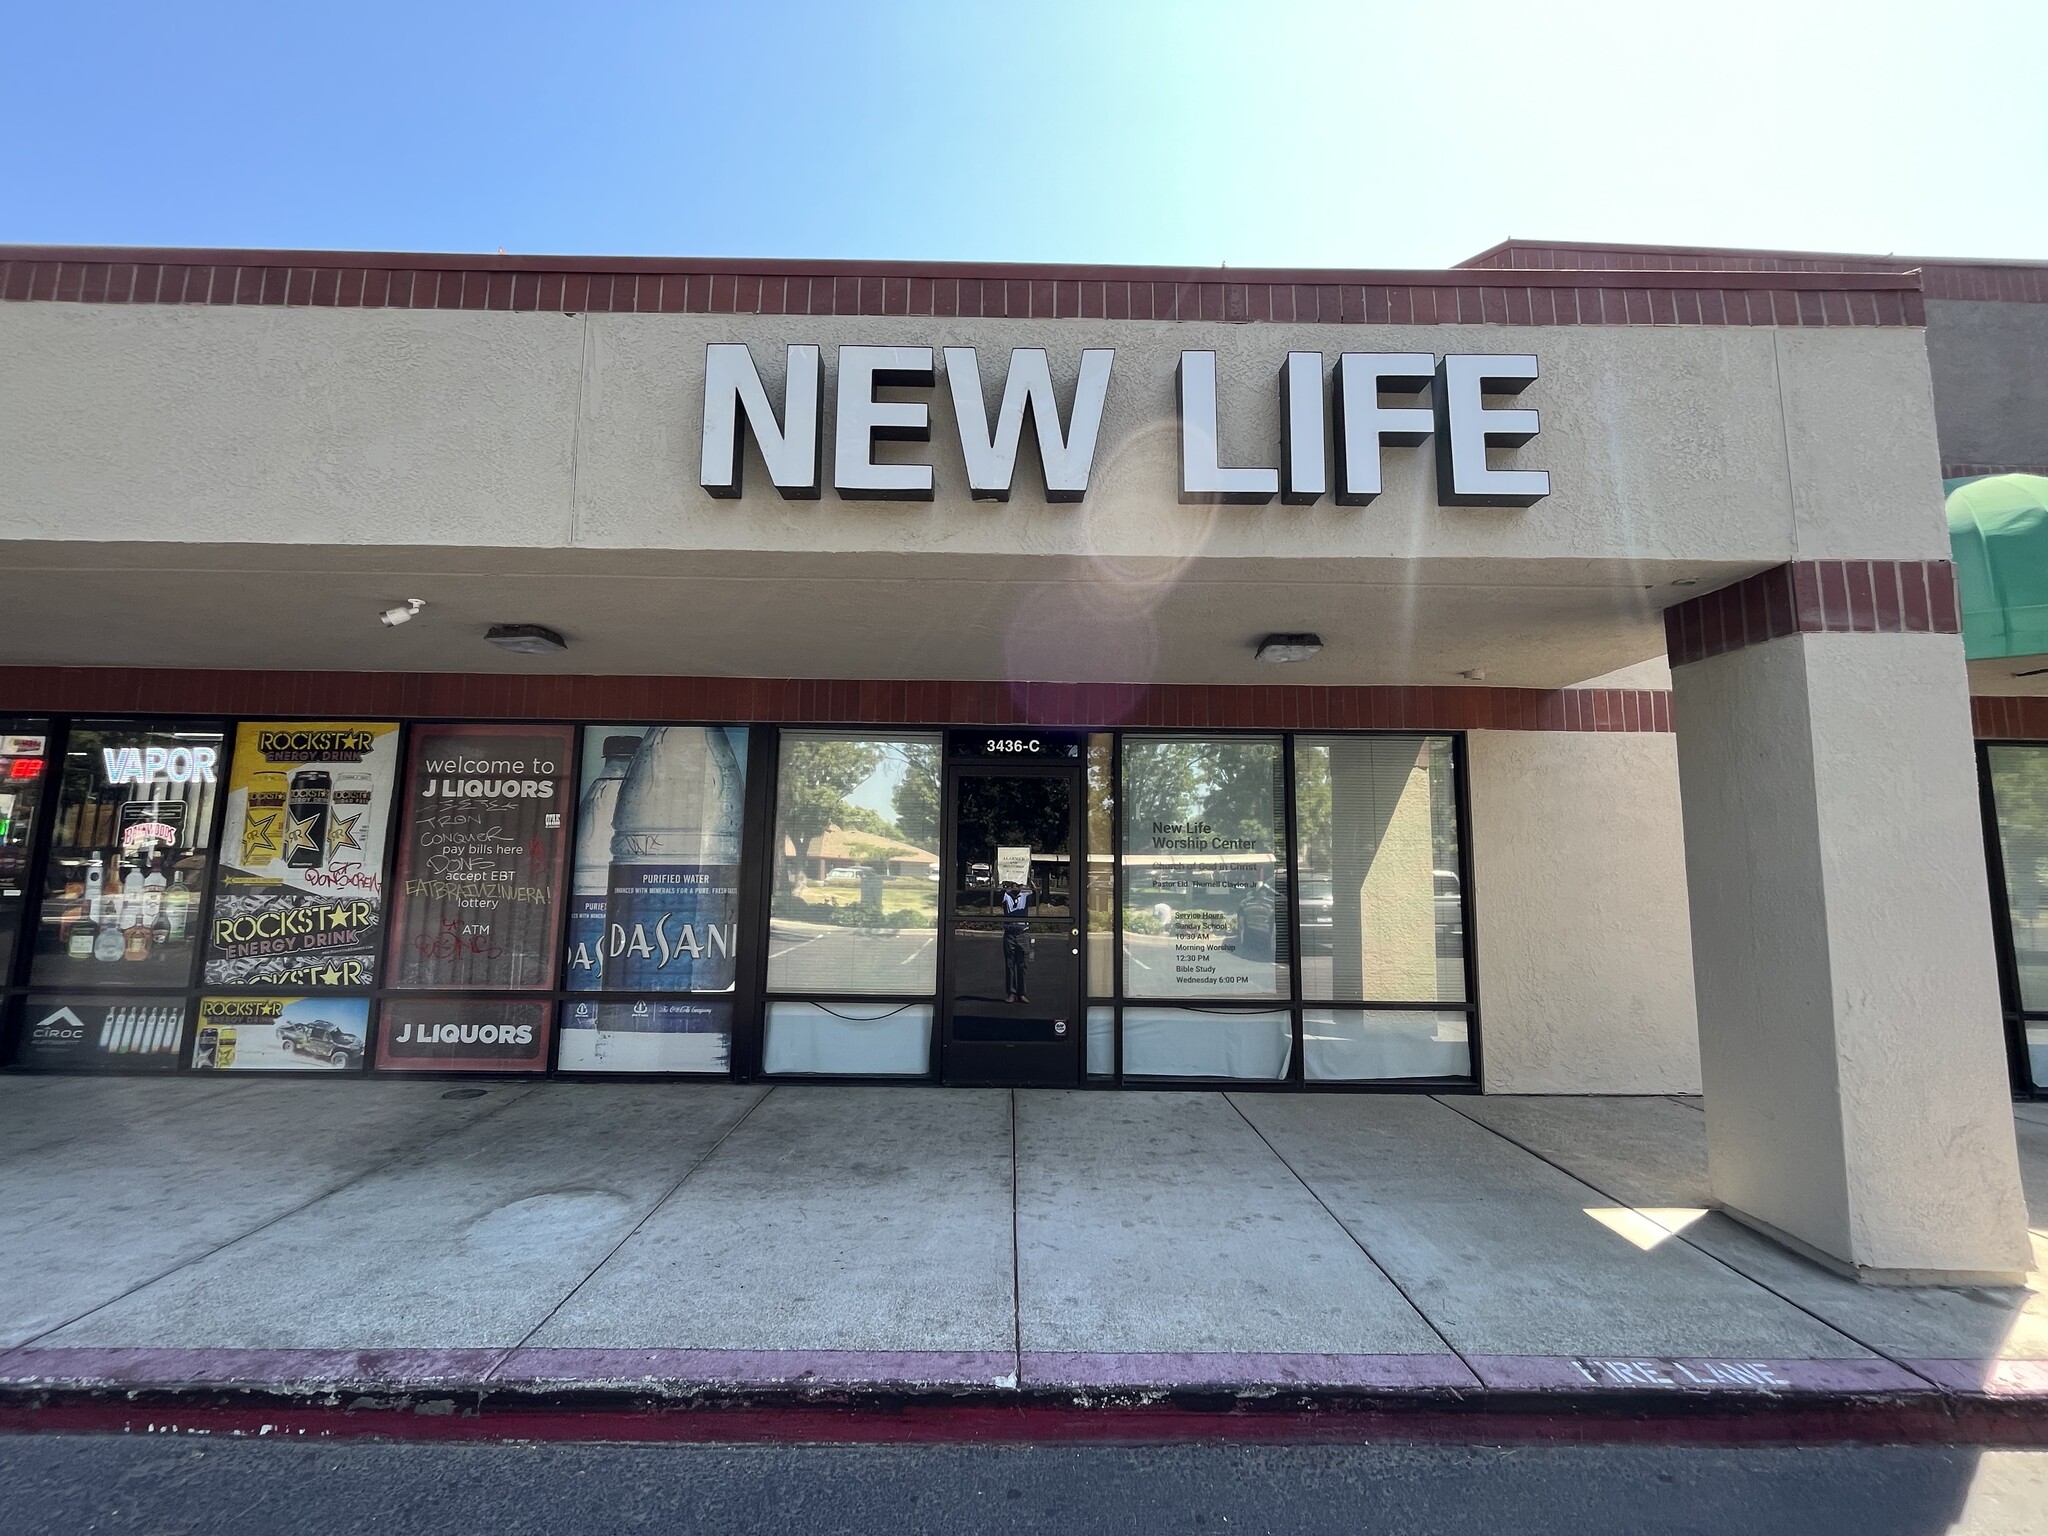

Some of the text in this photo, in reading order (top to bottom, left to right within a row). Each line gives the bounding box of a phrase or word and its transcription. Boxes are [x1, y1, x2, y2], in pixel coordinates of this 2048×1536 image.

[701, 343, 1550, 506] NEW LIFE
[987, 740, 1040, 752] 3436-C
[268, 751, 362, 761] ENERGY DRINK
[103, 747, 217, 784] VAPOR
[426, 756, 555, 774] welcome to
[422, 779, 554, 798] J LIQUORS
[1153, 822, 1211, 834] New Life
[442, 844, 523, 856] pay bills here
[1152, 837, 1256, 852] Worship Center
[1152, 862, 1257, 871] Church of God in Christ
[446, 871, 516, 882] accept EBT
[642, 874, 710, 884] PURIFIED WATER
[1152, 880, 1175, 888] Pastor
[458, 898, 499, 910] lottery
[1175, 912, 1201, 920] Service
[215, 902, 371, 945] ROCKSTAR
[1175, 922, 1227, 931] Sunday School
[462, 925, 490, 935] ATM
[228, 929, 358, 959] ENERGY DRINK
[609, 911, 737, 971] DASANI
[1176, 944, 1236, 952] Morning Worship
[1195, 966, 1216, 974] Study
[1176, 976, 1217, 984] Wednesday
[203, 1001, 282, 1016] ROCKSTAR
[396, 1023, 533, 1045] J LIQUORS
[1570, 1360, 1791, 1385] FIRE LANE
